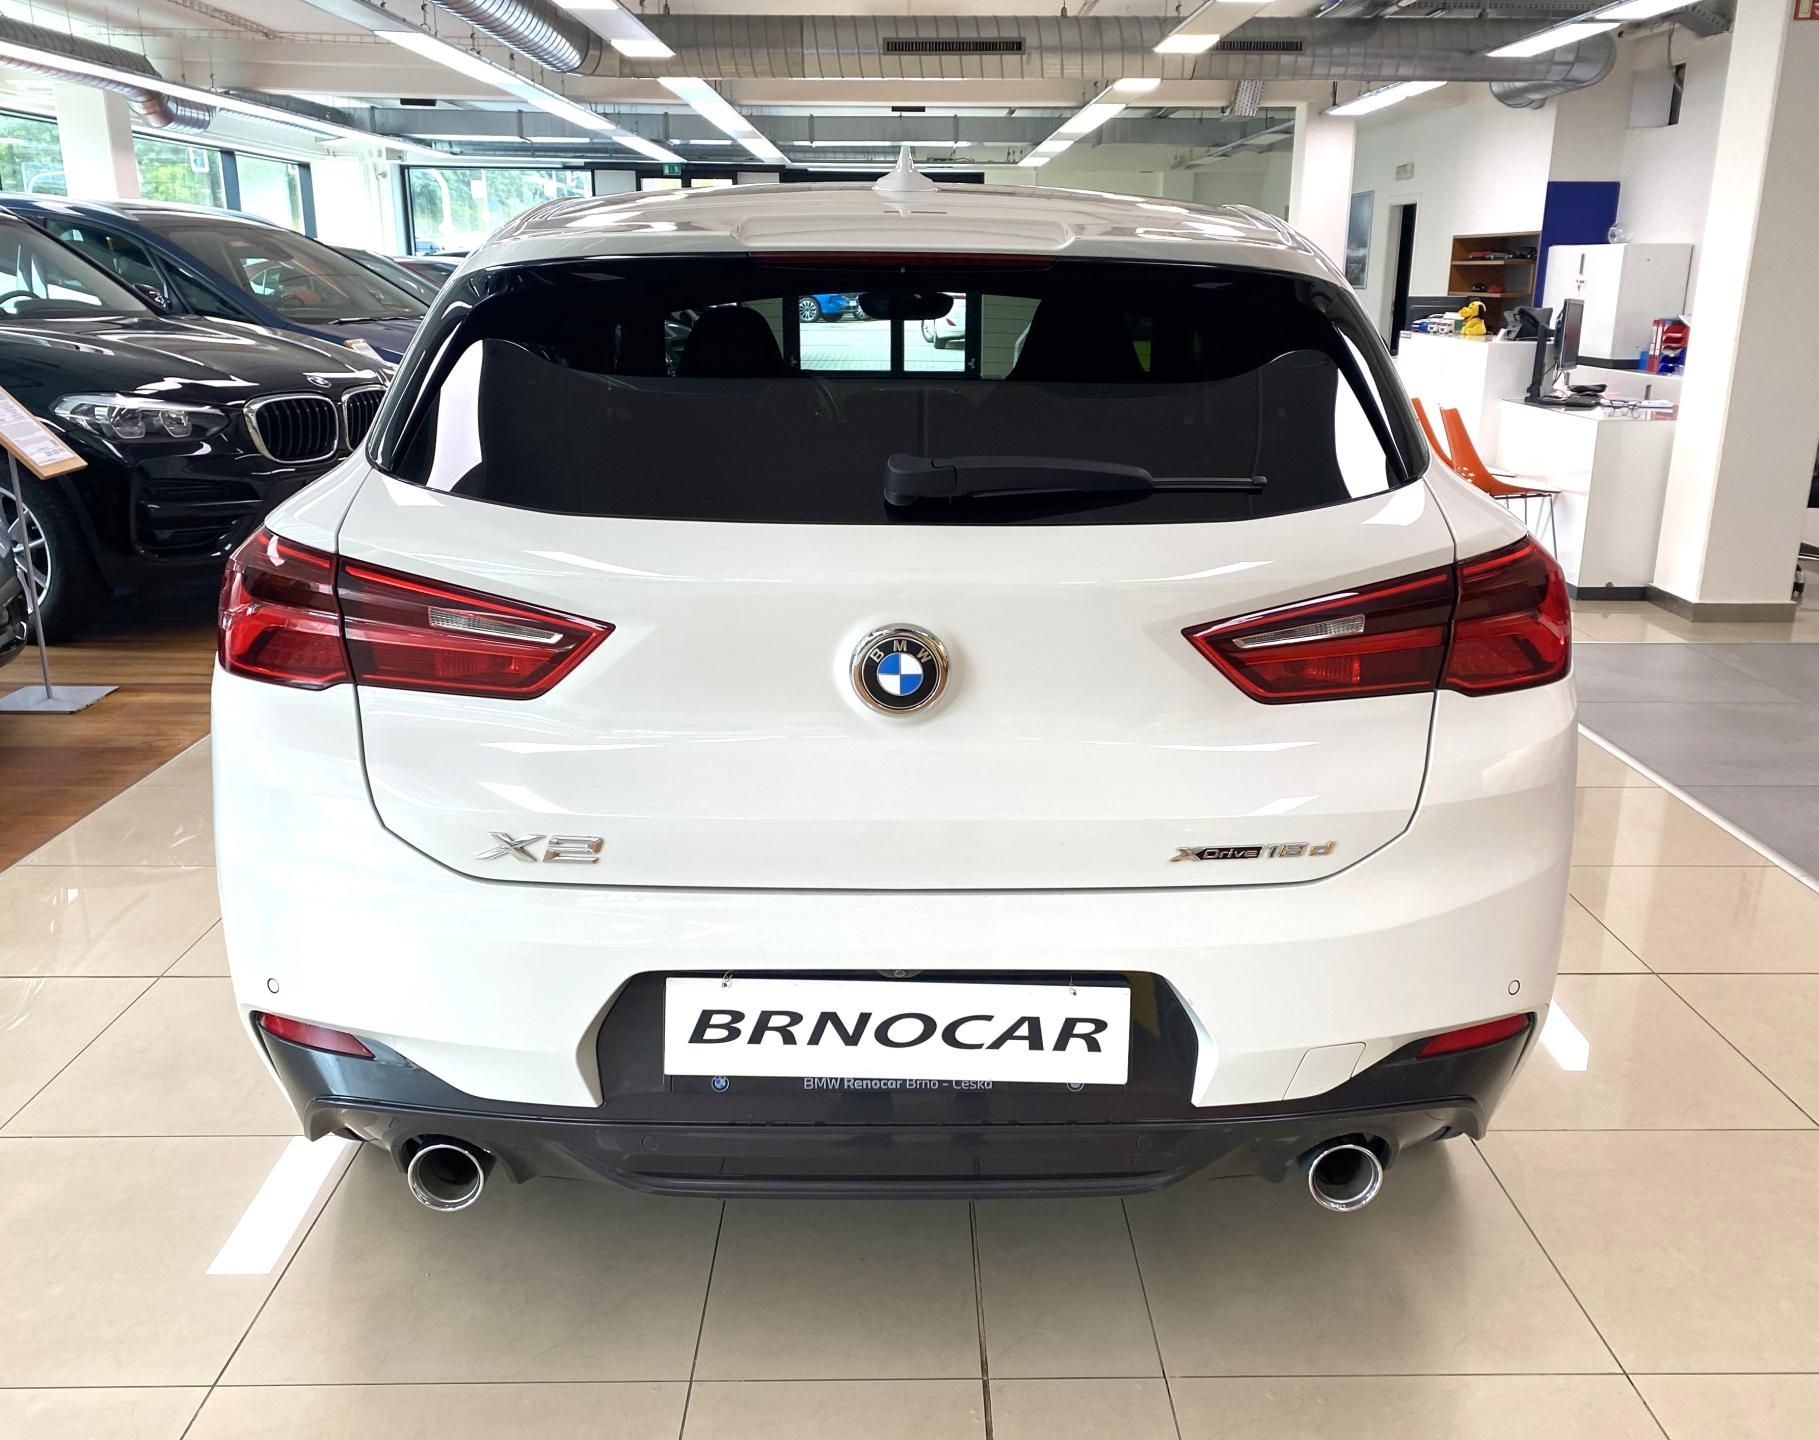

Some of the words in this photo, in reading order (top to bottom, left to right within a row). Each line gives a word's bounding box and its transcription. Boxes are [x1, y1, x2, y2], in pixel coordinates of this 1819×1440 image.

[870, 639, 933, 664] BMW
[475, 831, 605, 865] X2
[687, 1008, 1109, 1053] BRNOCAR
[803, 1077, 841, 1090] BMW
[844, 1077, 902, 1090] Renocar
[906, 1078, 939, 1090] Brno
